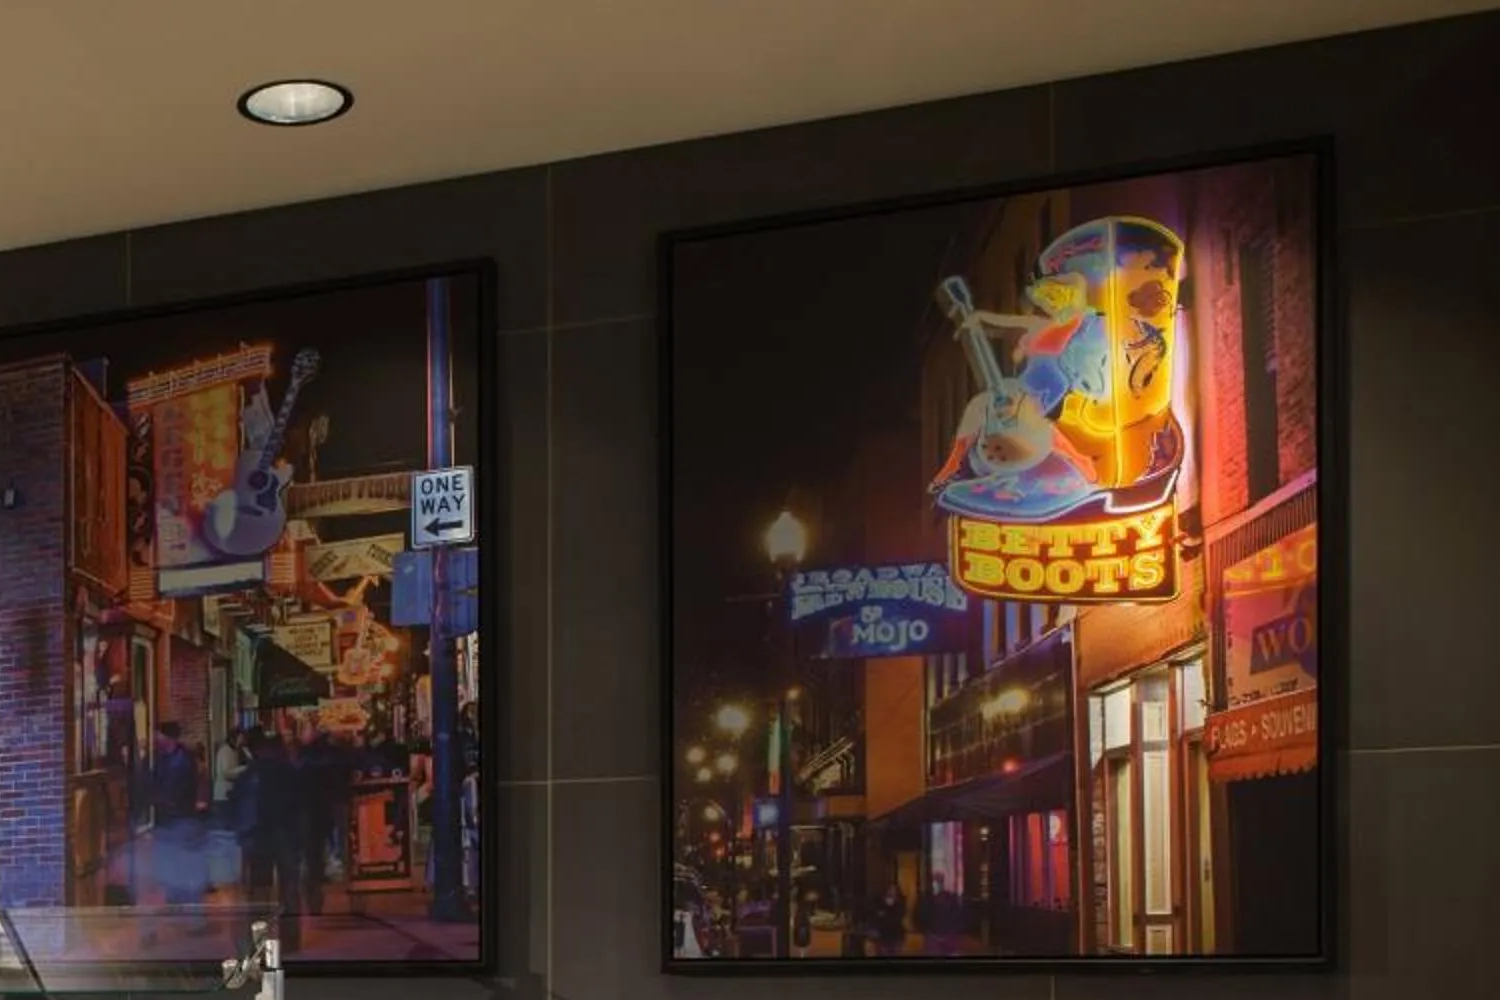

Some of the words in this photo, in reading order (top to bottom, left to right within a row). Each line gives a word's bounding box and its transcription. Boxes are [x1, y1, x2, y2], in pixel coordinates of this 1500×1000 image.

[421, 474, 464, 495] ONE
[421, 493, 466, 514] WAY
[960, 504, 1175, 557] BETTY
[963, 549, 1165, 594] BOOTS
[852, 619, 929, 651] MOJO
